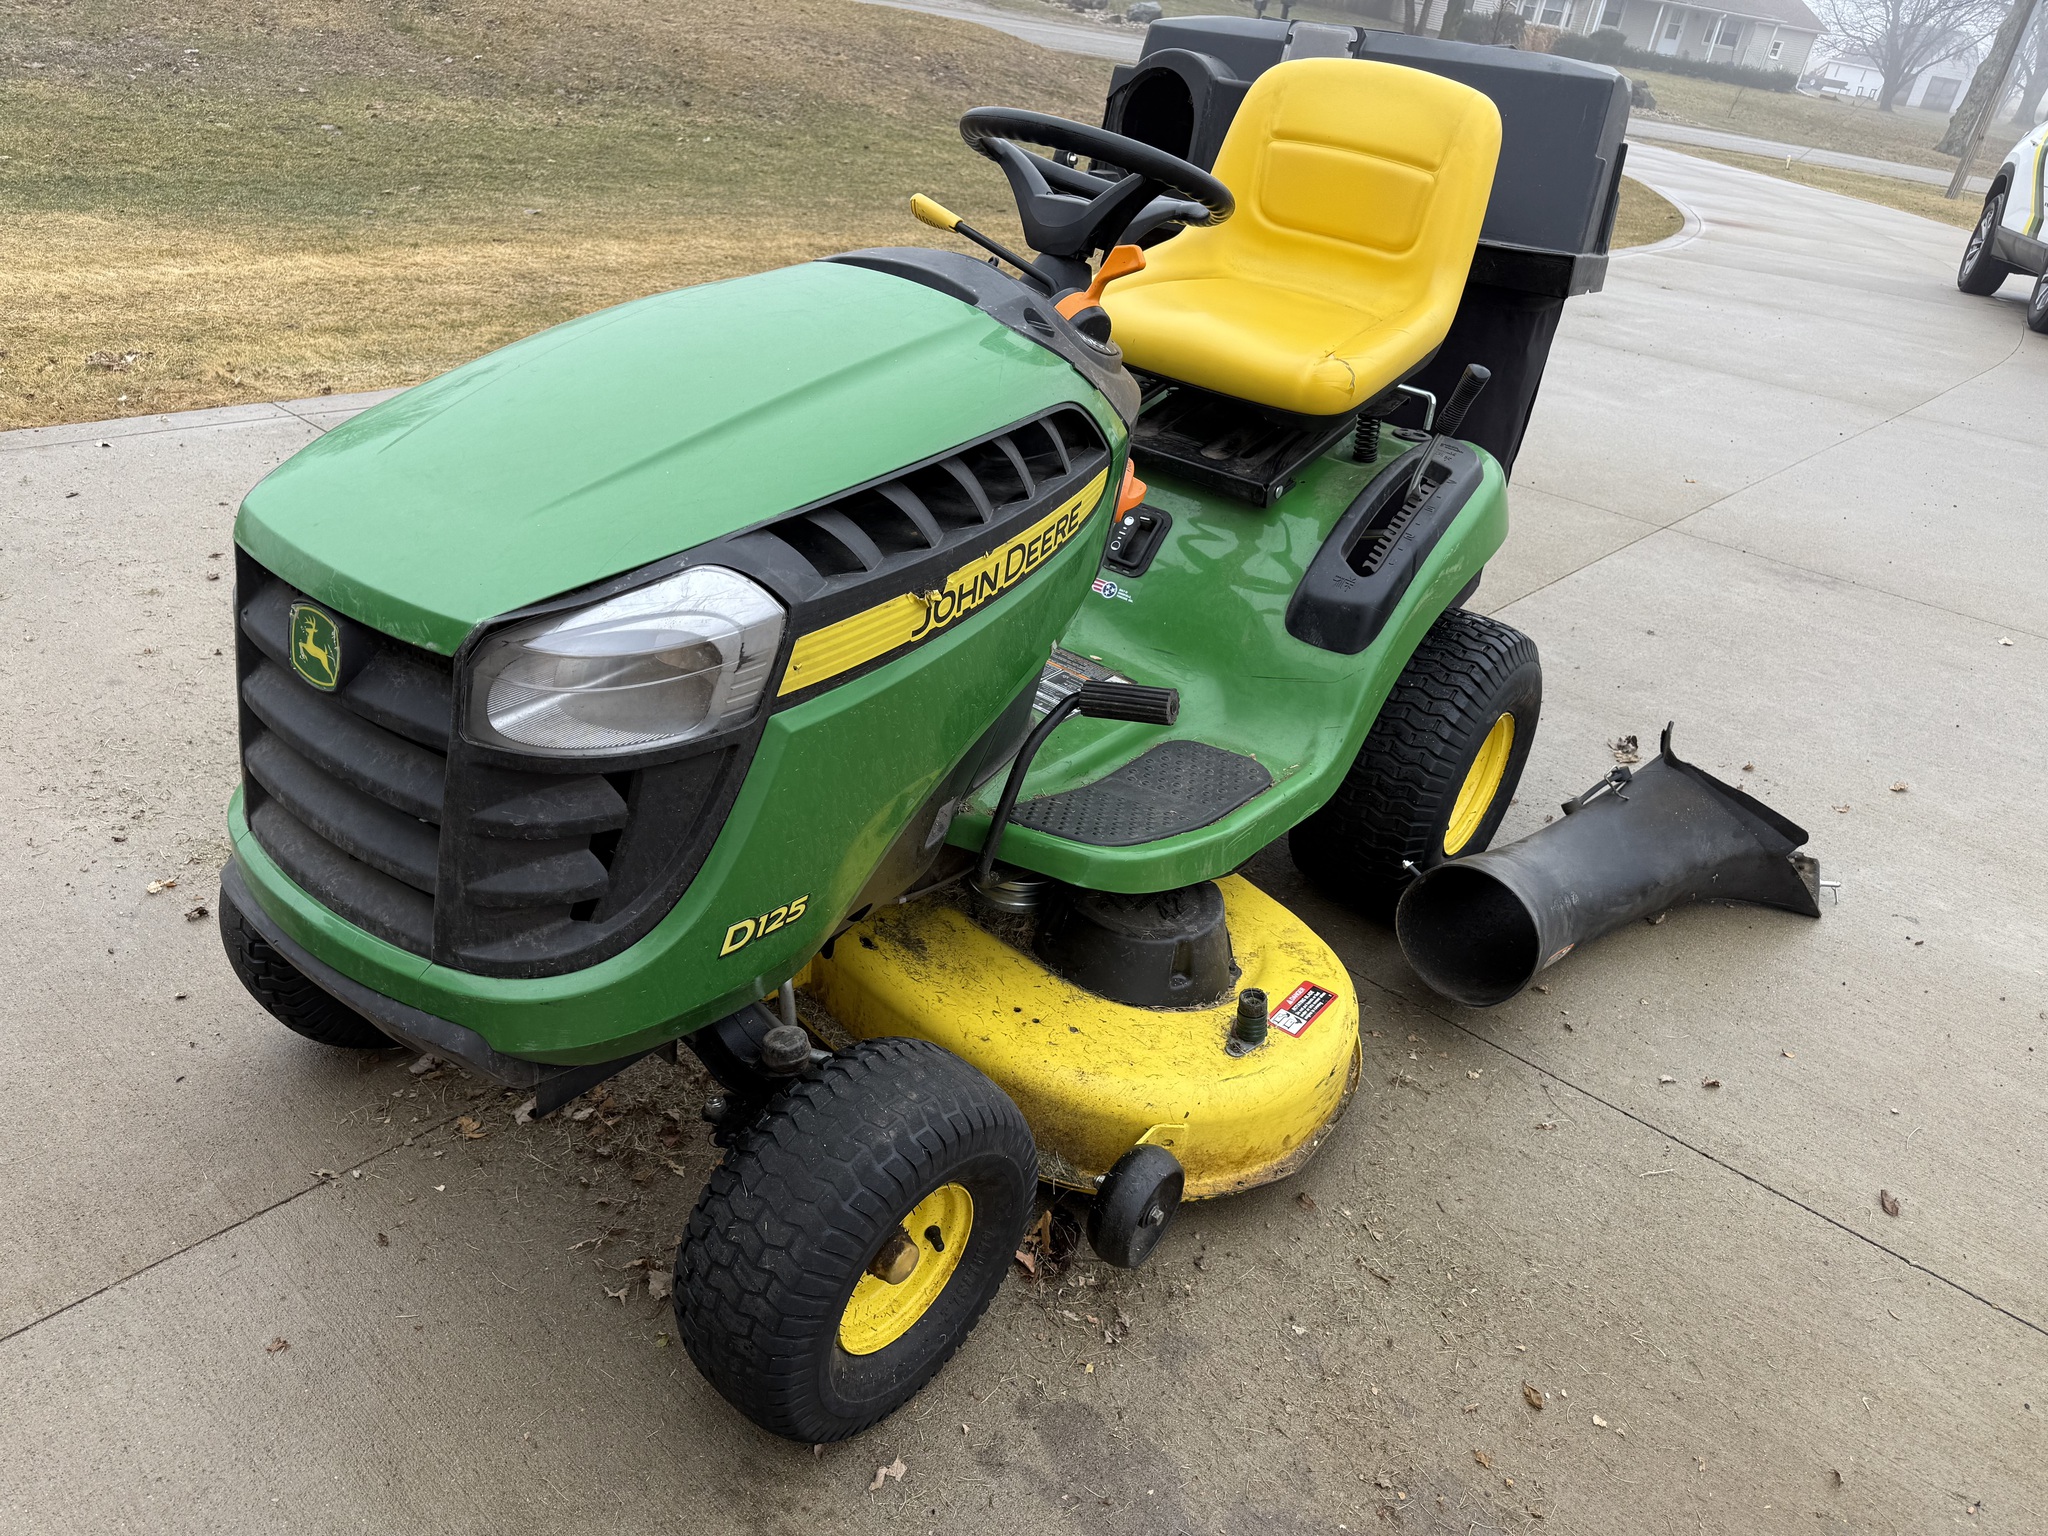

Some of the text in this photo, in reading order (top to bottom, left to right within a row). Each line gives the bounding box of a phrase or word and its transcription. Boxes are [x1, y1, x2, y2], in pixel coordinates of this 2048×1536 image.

[911, 501, 1082, 638] JOHN DEERE
[719, 893, 810, 958] D125
